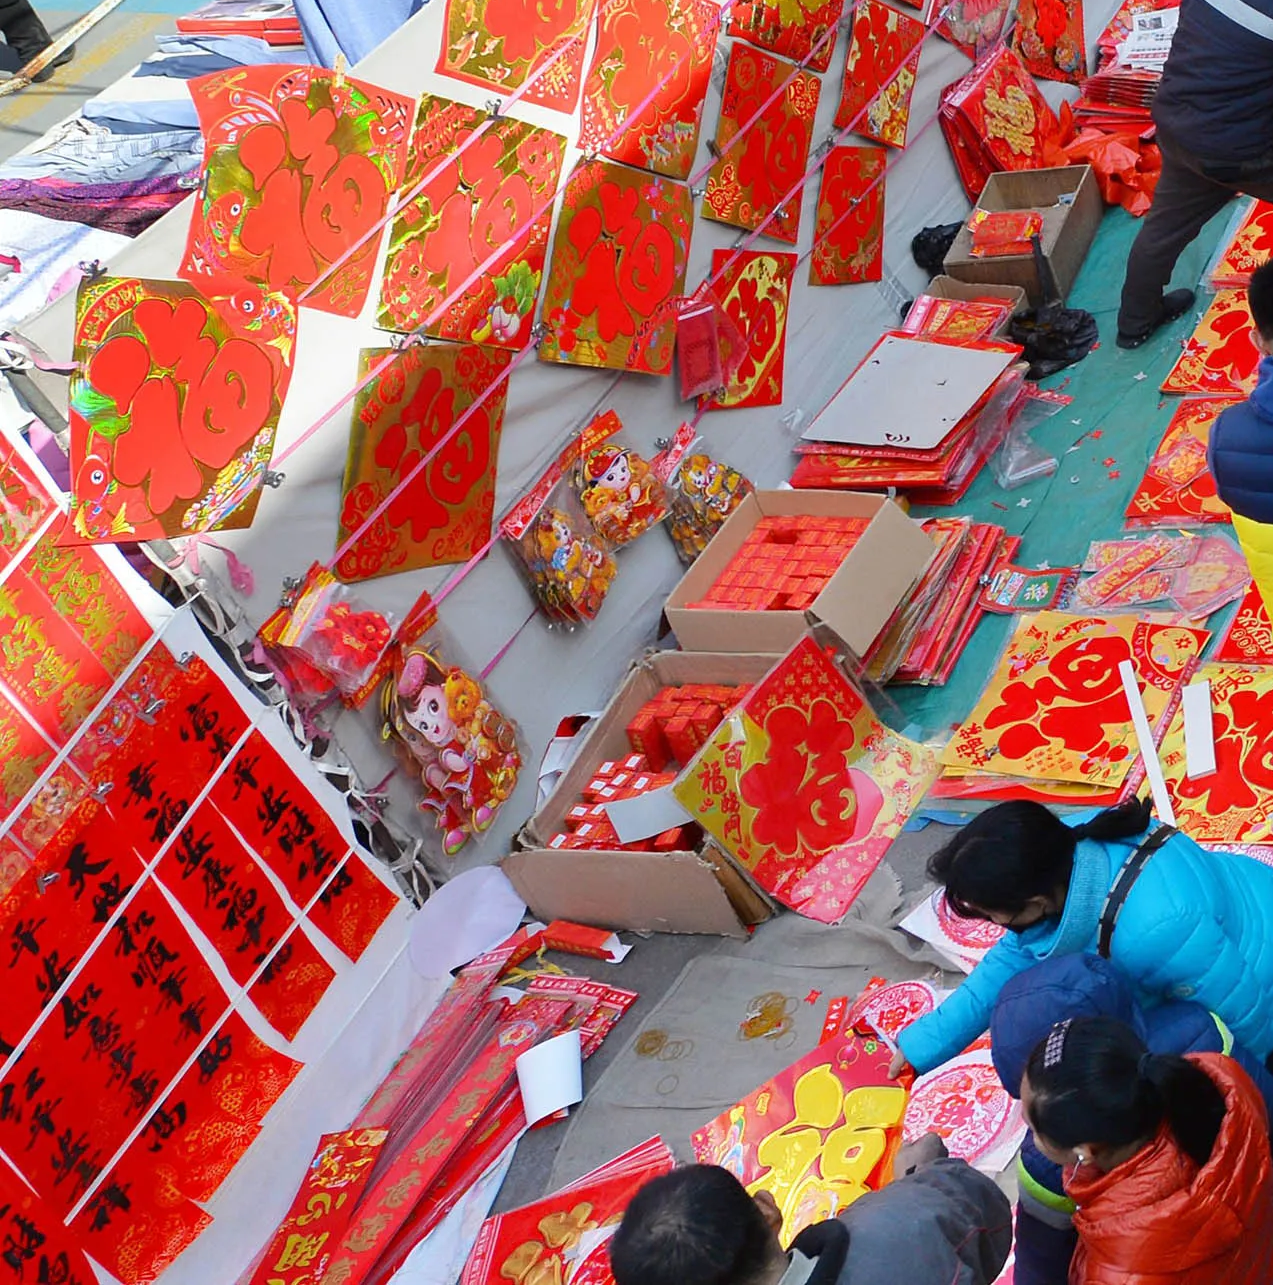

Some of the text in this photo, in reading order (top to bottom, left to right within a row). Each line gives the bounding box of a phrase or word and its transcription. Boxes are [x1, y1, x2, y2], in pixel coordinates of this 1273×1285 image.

[542, 55, 580, 94] 祥
[234, 97, 390, 289] 福
[416, 124, 532, 292] 福
[566, 178, 676, 340] 福
[86, 296, 278, 508] 福
[376, 366, 490, 541] 福
[738, 698, 885, 857] 福
